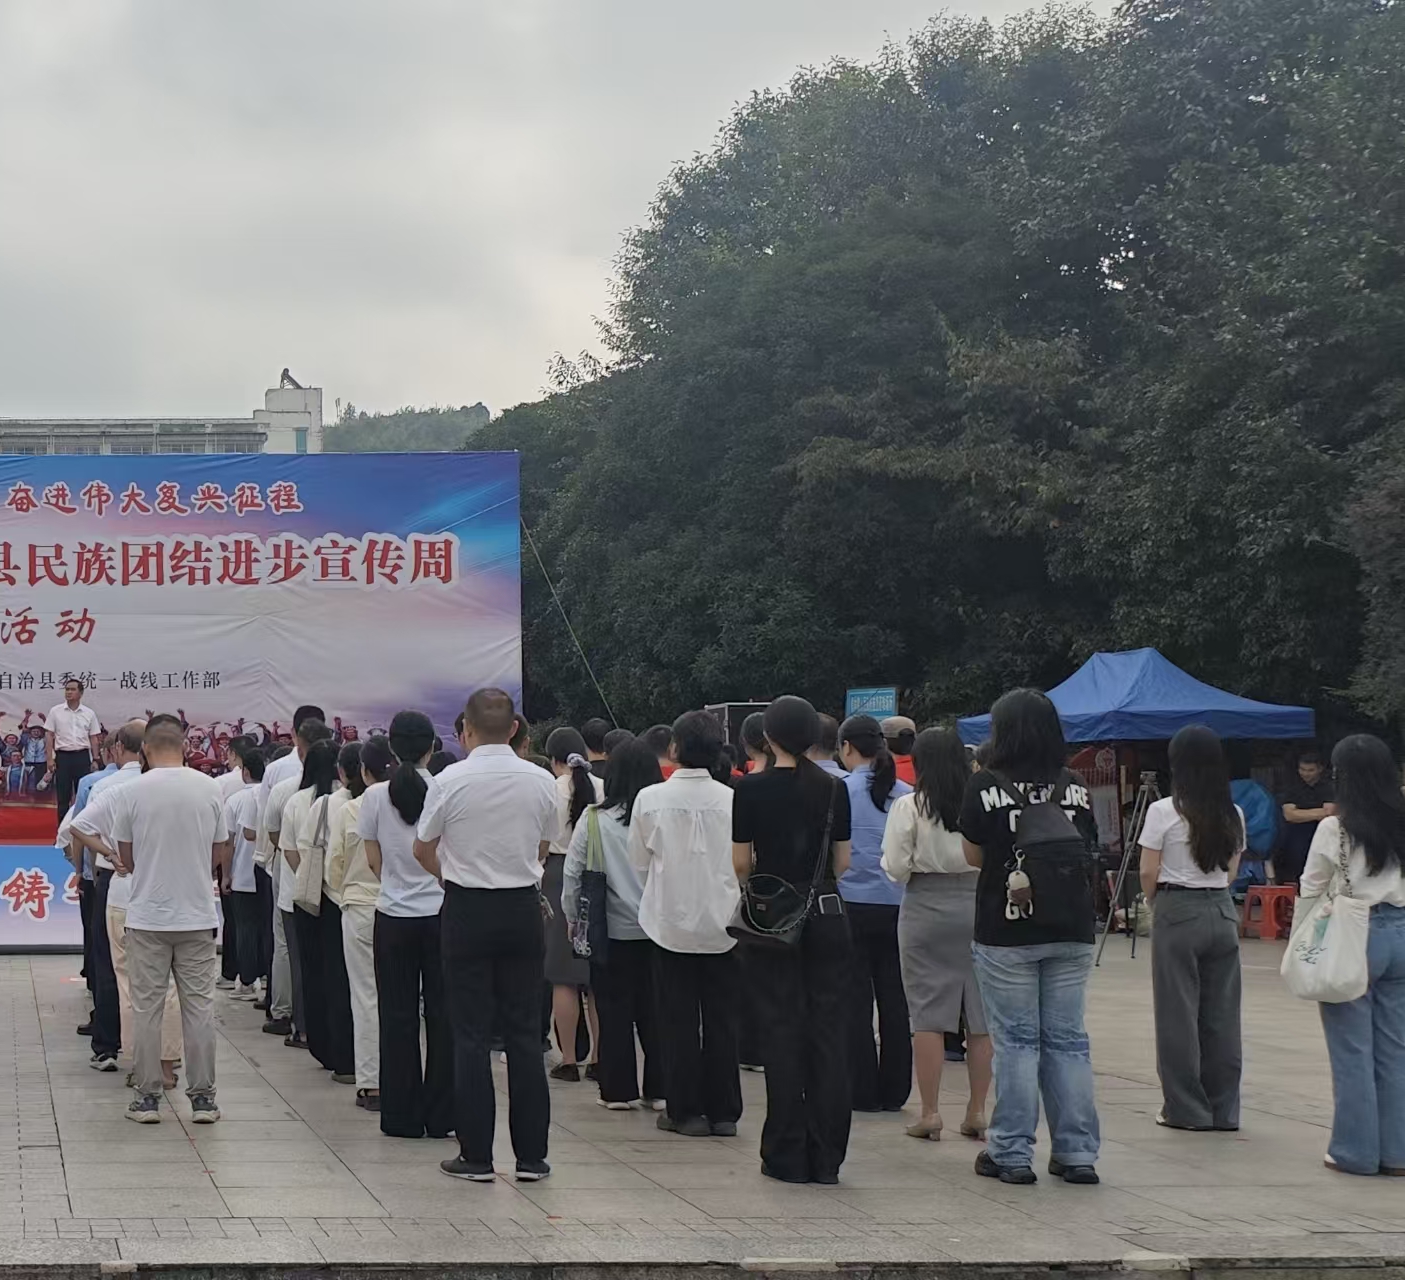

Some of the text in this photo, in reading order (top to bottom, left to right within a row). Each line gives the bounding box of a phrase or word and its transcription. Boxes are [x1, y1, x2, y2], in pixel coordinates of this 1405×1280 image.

[8, 482, 302, 515] 奋进伟大复兴征程
